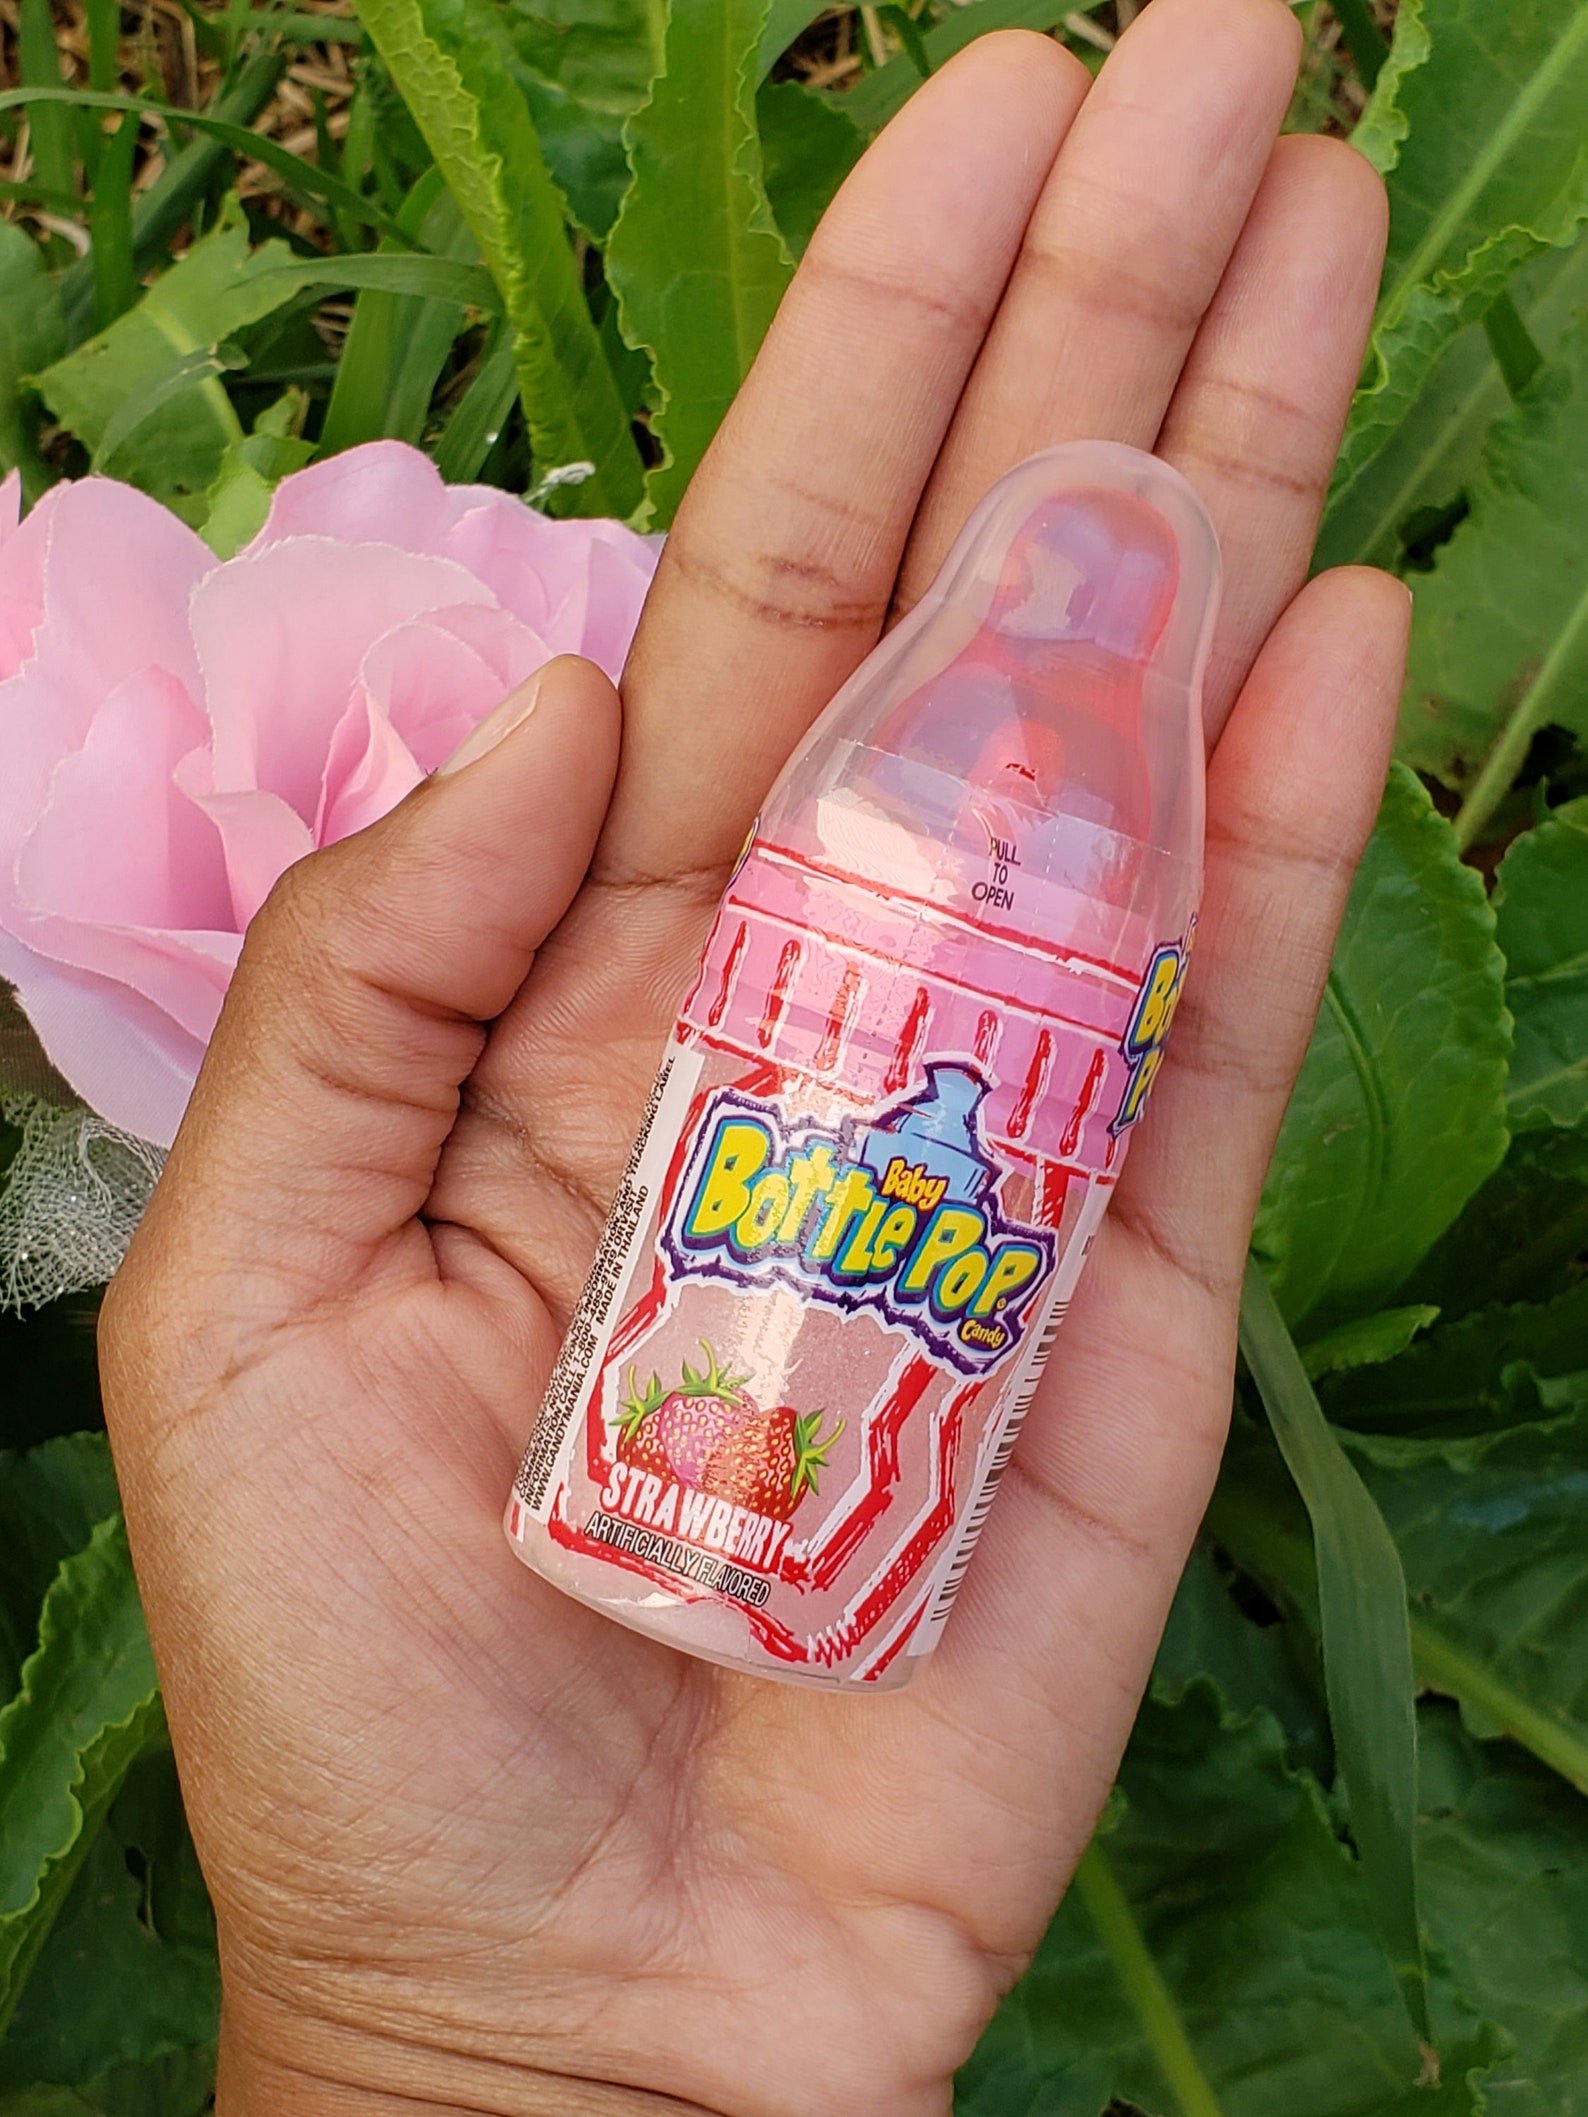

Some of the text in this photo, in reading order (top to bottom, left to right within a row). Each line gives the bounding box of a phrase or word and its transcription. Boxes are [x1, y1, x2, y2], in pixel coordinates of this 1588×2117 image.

[988, 836, 1021, 866] PULL
[992, 862, 1008, 885] TO
[971, 882, 1015, 911] OPEN
[619, 1179, 633, 1211] AND
[631, 1104, 659, 1176] TRACKING
[880, 1158, 948, 1211] Baby
[531, 1333, 600, 1511] WWW.CANDYMANIA.COM
[596, 1279, 618, 1325] MADE
[612, 1261, 624, 1279] IN
[618, 1184, 650, 1260] THAILAND
[960, 1319, 1006, 1348] Candy
[524, 1405, 563, 1506] INFORMATION
[560, 1368, 576, 1404] CALL
[574, 1249, 618, 1364] 1-800-489-9149
[602, 1462, 791, 1569] STRAWBERRY
[584, 1512, 770, 1607] ARTIFICIALLY FLAVORED
